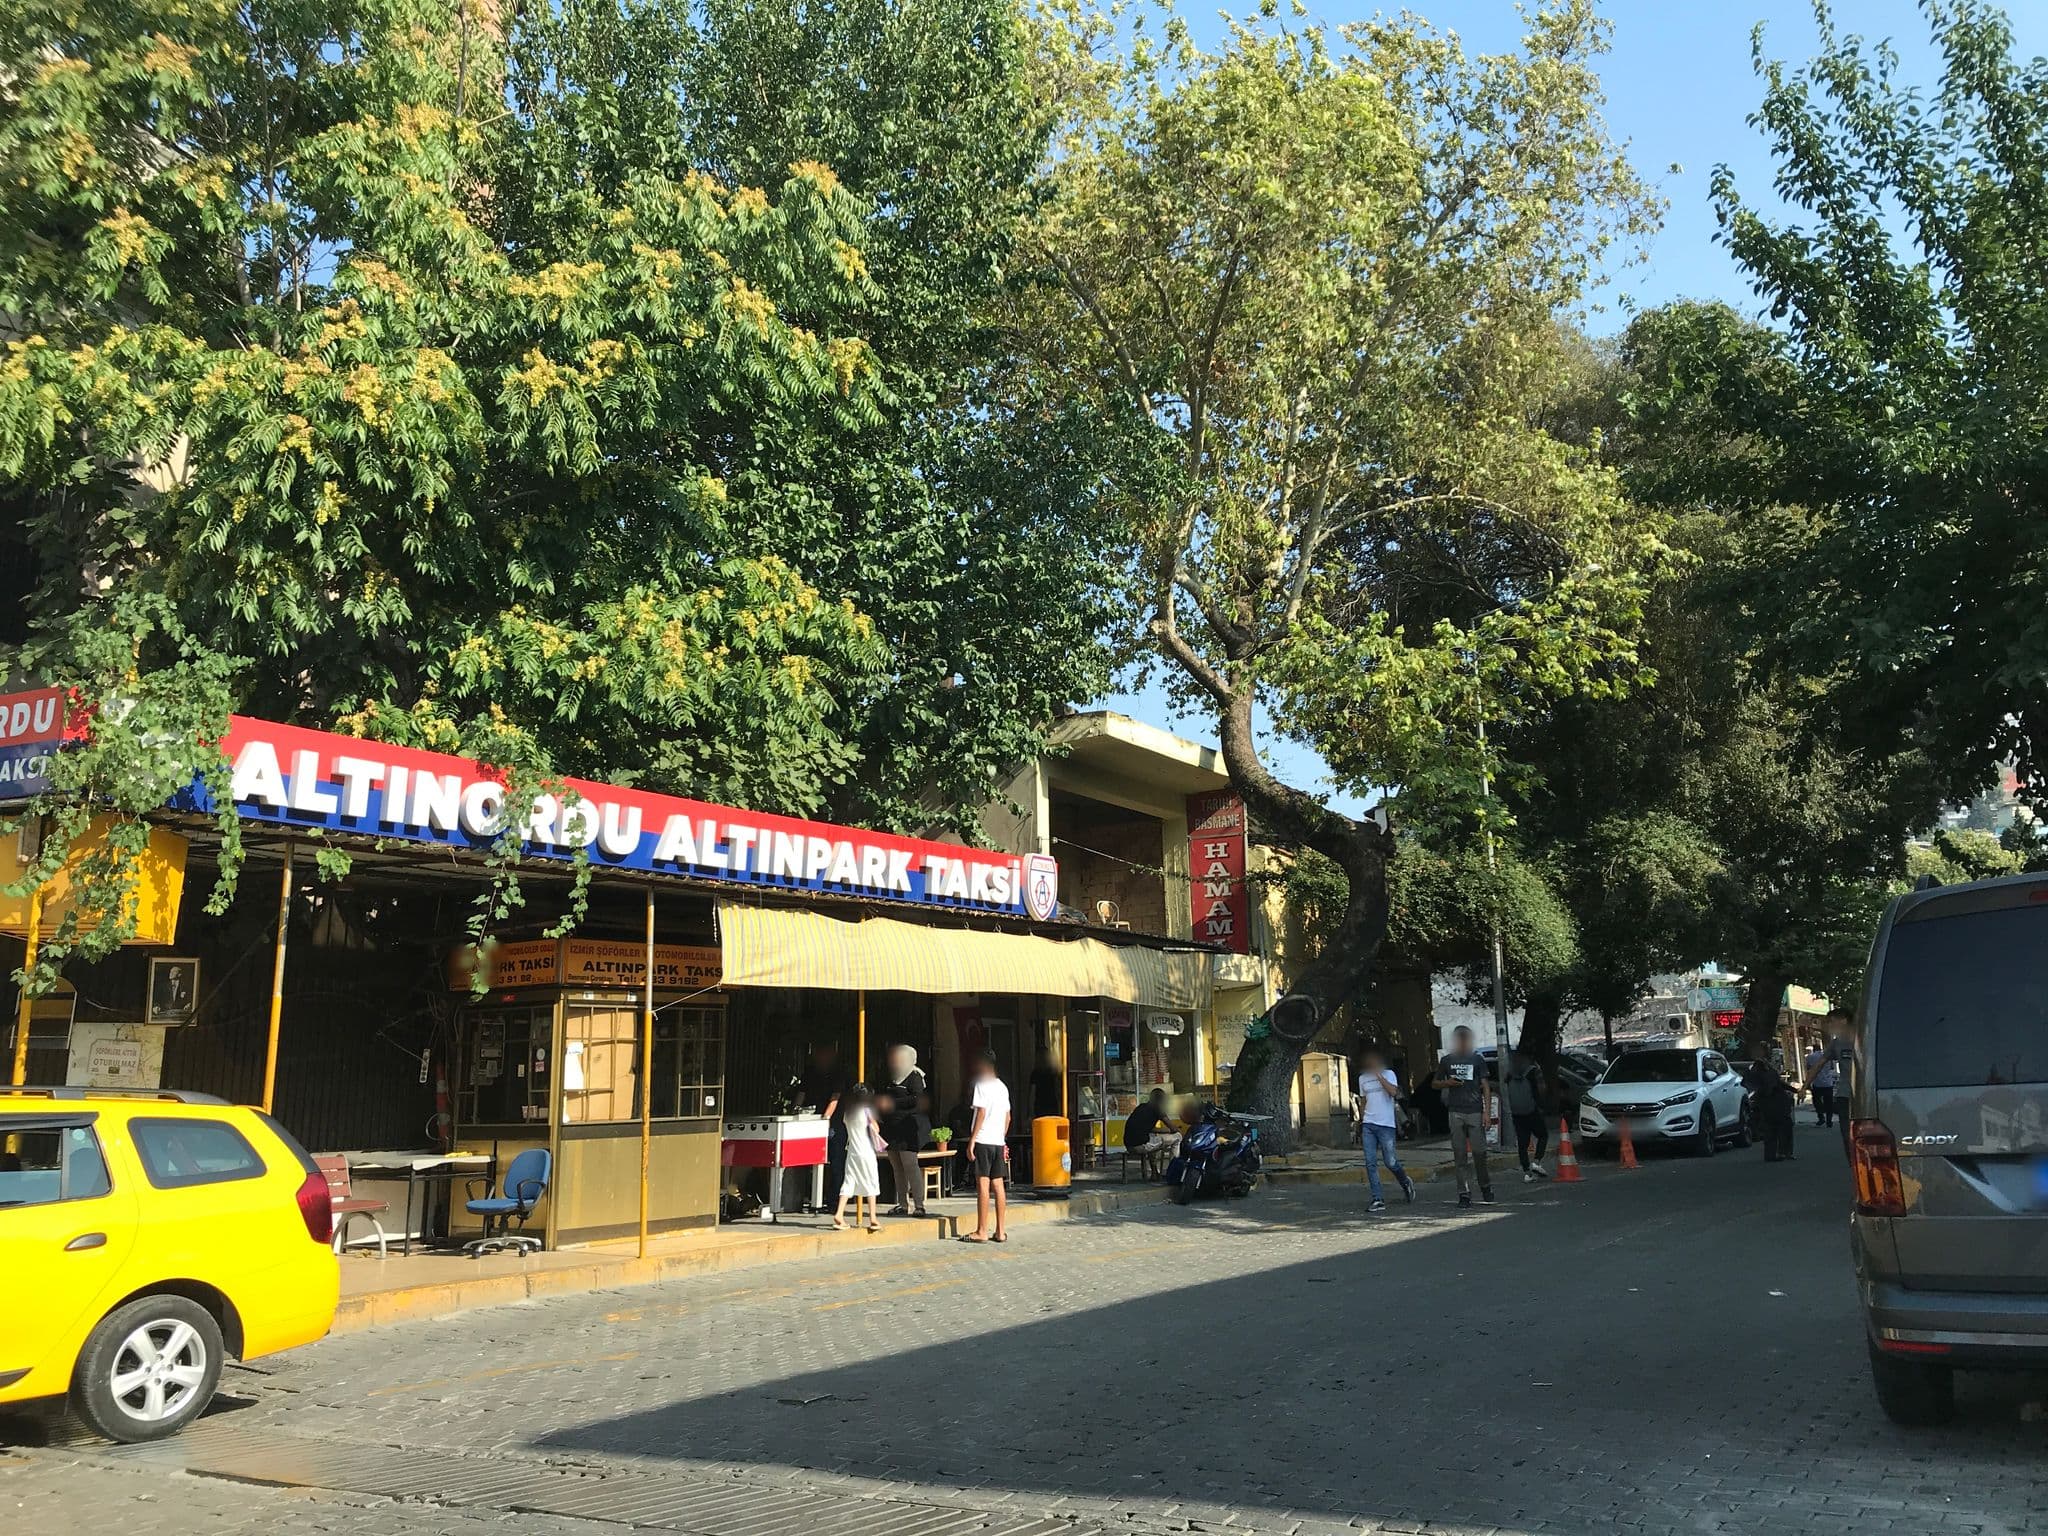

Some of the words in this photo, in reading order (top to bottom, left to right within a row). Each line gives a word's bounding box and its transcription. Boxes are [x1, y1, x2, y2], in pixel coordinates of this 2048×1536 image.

[230, 741, 642, 855] ALTINORDU
[652, 814, 912, 892] ALTINPARK
[920, 855, 1020, 905] TAKSİ
[1195, 814, 1240, 831] BASMANE
[519, 955, 554, 971] TAKSİ
[1901, 1134, 1959, 1145] CADDY
